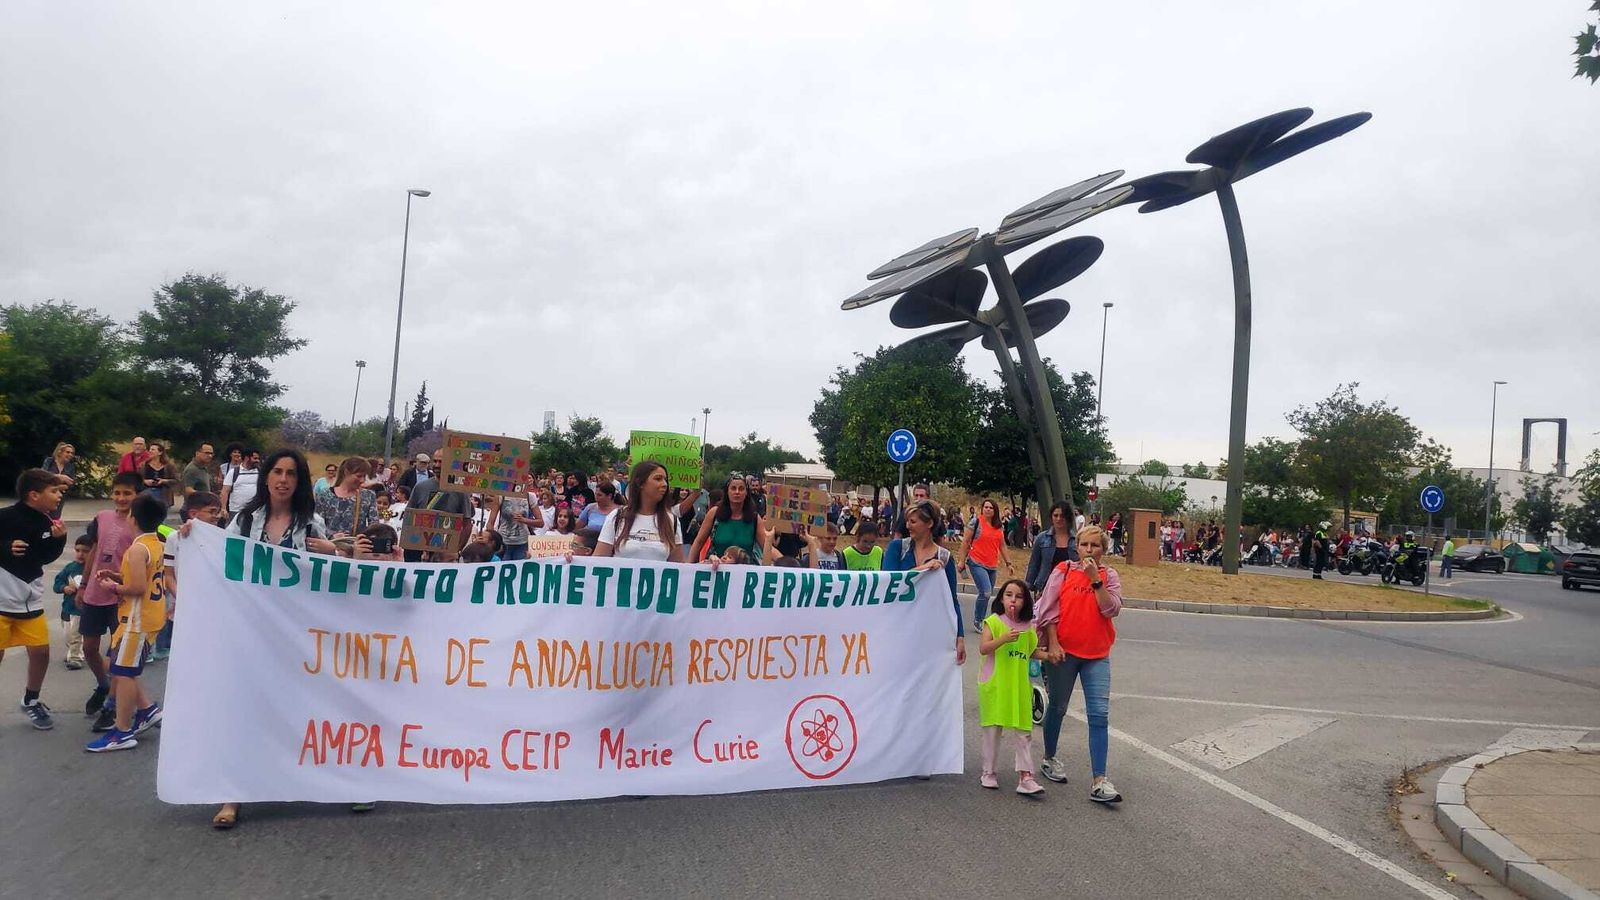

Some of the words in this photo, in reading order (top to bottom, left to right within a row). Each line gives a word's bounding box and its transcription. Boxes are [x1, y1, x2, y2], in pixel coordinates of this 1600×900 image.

[631, 435, 681, 449] INSTITUTO
[684, 439, 699, 452] YA
[665, 454, 699, 470] NIÑOS
[678, 473, 698, 484] VAN
[225, 538, 457, 604] INSTITUTO
[471, 561, 680, 615] PROMETIDO
[692, 570, 732, 610] EN
[741, 570, 919, 610] BERMEJALES
[303, 628, 418, 685] JUNTA
[445, 638, 490, 688] DE
[507, 638, 674, 692] ANDALUCIA
[687, 634, 829, 685] RESPUESTA
[840, 631, 872, 676] YA
[298, 718, 385, 768] AMPA
[397, 723, 492, 783] Europa
[501, 728, 572, 771] CEIP
[598, 726, 674, 771] Marie
[692, 718, 760, 765] Curie
